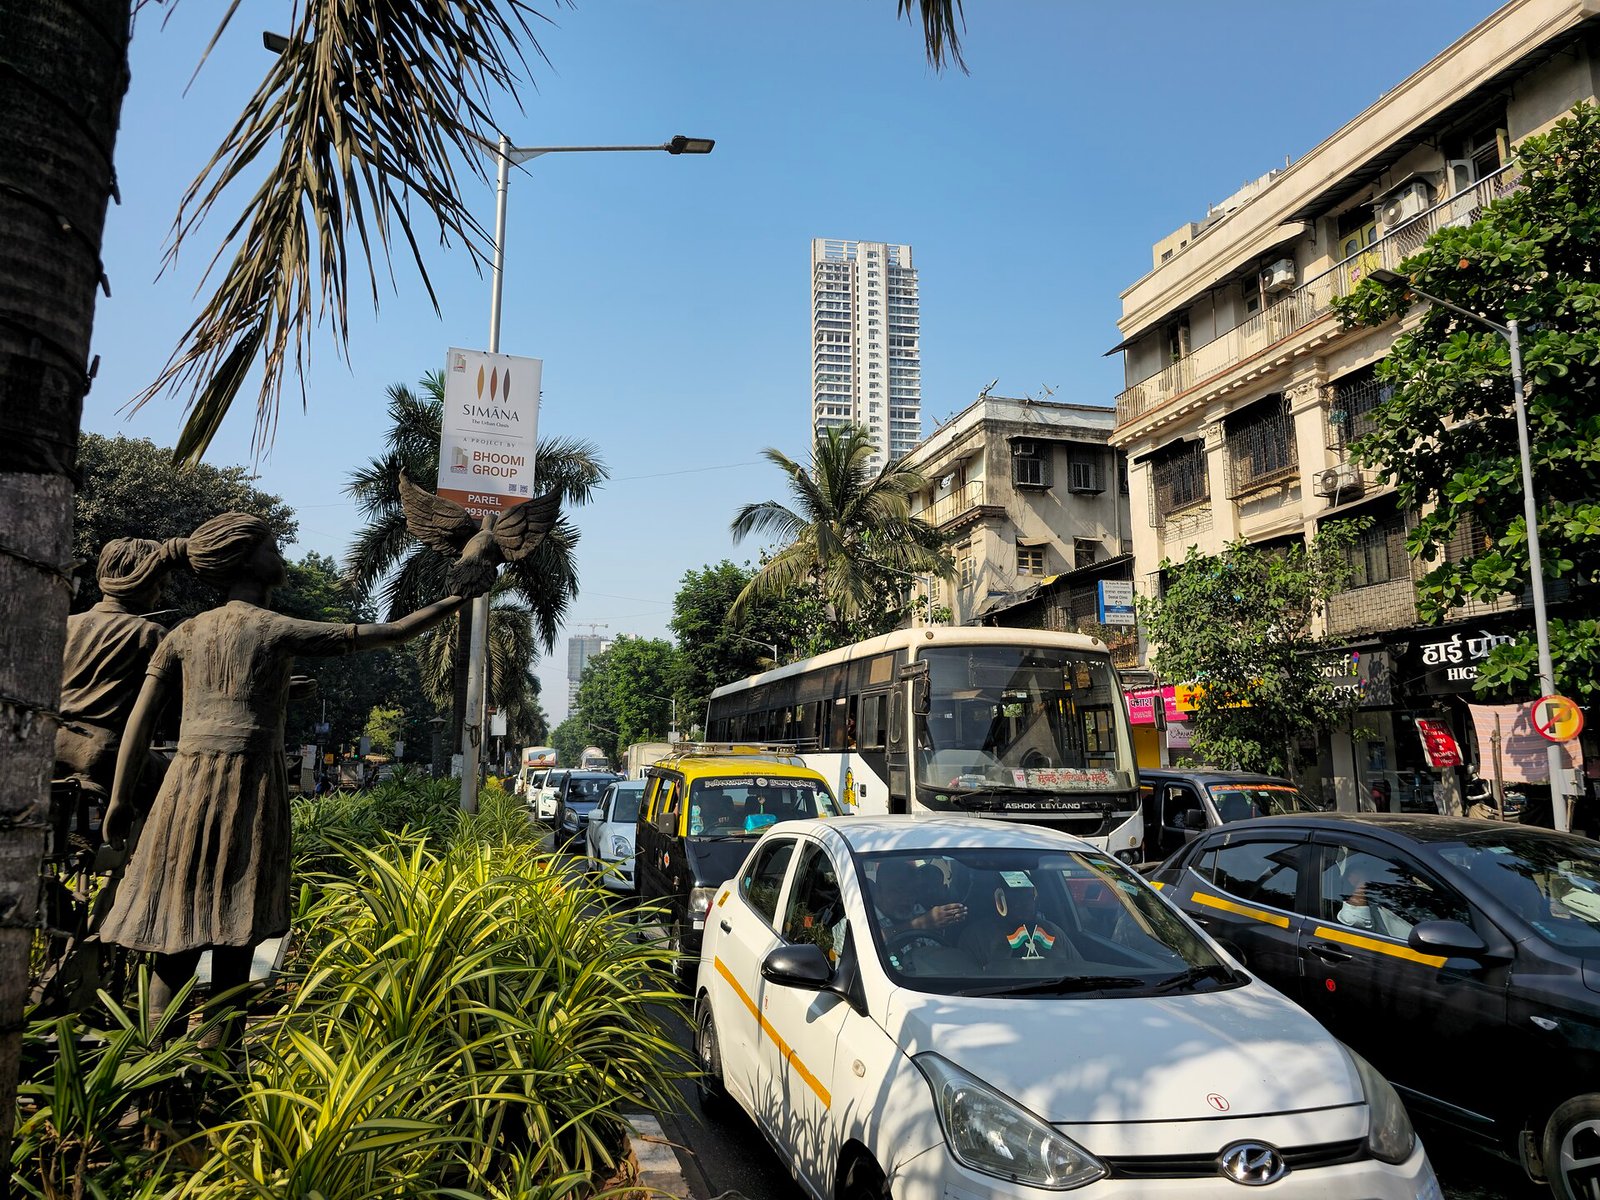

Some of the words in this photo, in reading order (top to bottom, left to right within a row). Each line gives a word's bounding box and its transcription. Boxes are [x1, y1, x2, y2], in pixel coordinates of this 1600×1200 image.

[471, 438, 503, 446] PROJECT
[473, 451, 525, 467] BHOOMI
[472, 464, 518, 478] GROUP
[467, 494, 502, 506] PAREL
[1420, 633, 1463, 665] हाई
